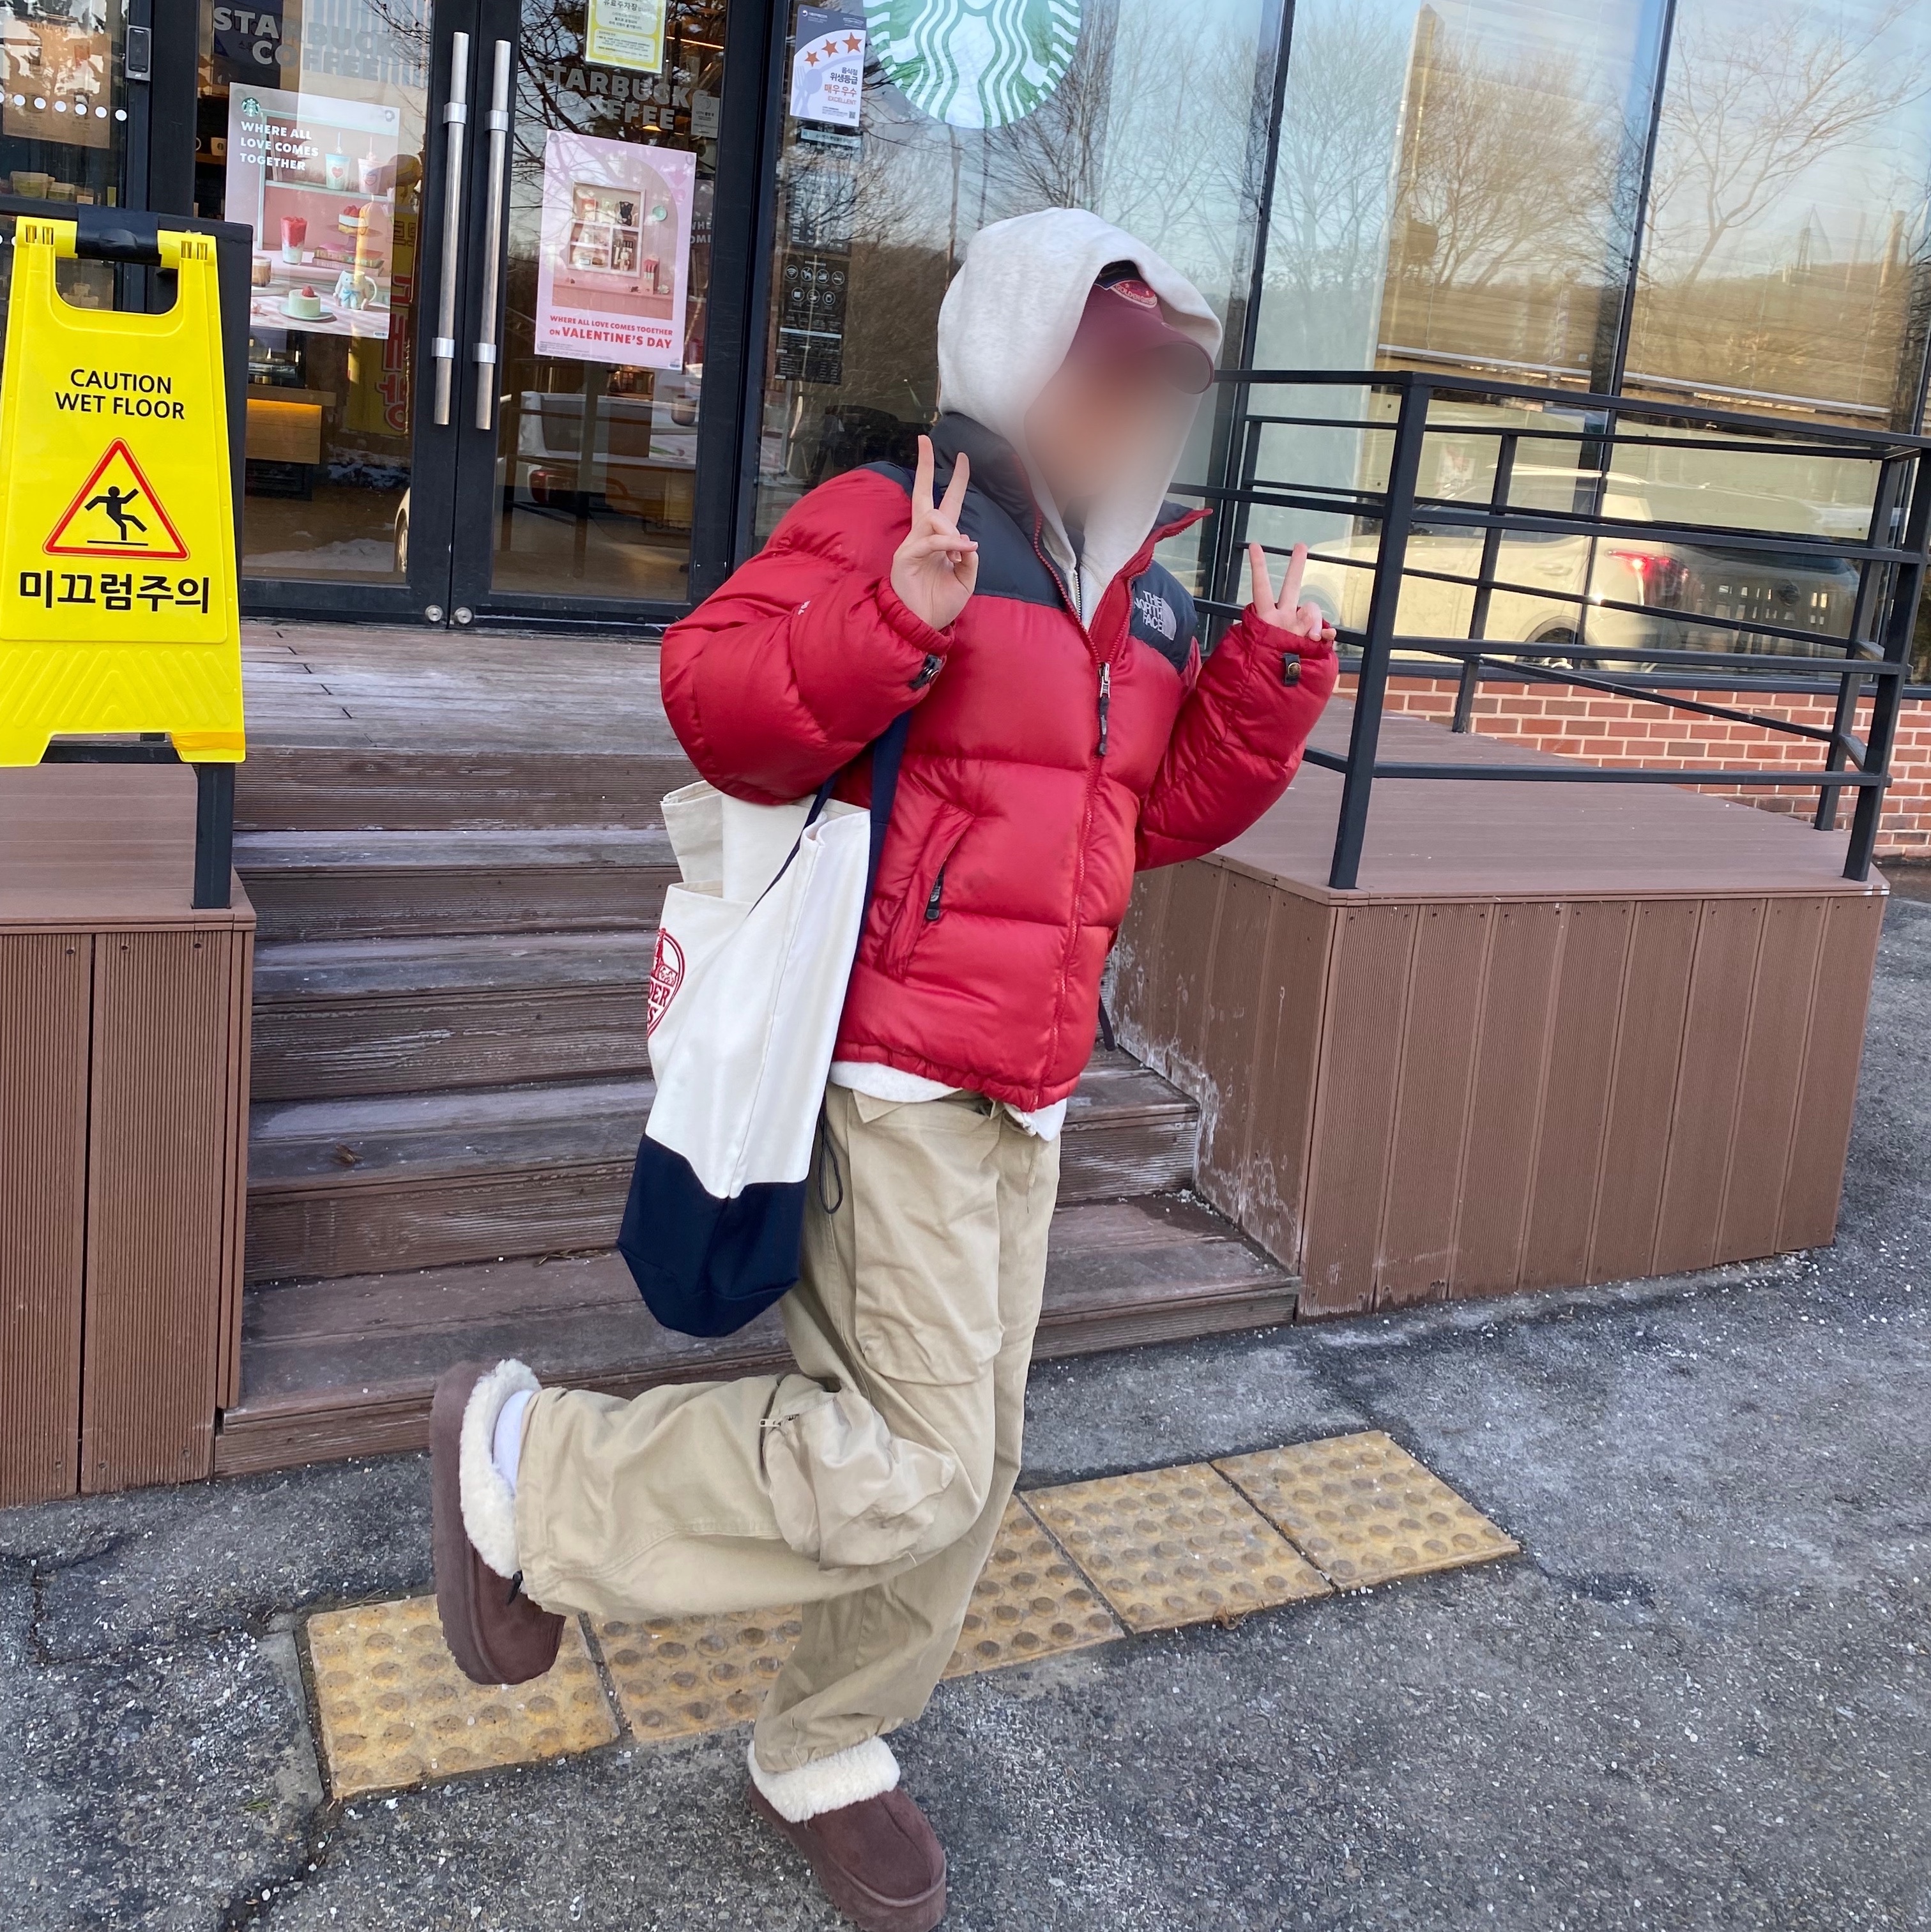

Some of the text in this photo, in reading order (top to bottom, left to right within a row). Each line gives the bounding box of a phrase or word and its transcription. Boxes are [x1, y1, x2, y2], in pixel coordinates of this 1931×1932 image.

[830, 72, 858, 85] 위생등급
[825, 84, 857, 97] 매우 우수
[828, 95, 857, 105] EXCELLENT
[240, 121, 312, 140] WHERE ALL
[240, 137, 319, 157] LOVE COMES
[240, 153, 306, 171] TOGETHER
[550, 315, 577, 324] WHERE
[592, 320, 609, 328] LOVE
[610, 323, 635, 331] COMES
[636, 326, 673, 336] TOGETHER
[562, 326, 643, 346] VALENTINE'S
[647, 337, 672, 349] DAY
[70, 369, 172, 394] CAUTION
[55, 392, 185, 420] WET FLOOR
[20, 570, 210, 614] 미끄럼주의
[1143, 590, 1163, 606] THE
[1134, 597, 1163, 620] NORTH
[1143, 611, 1164, 632] FACE
